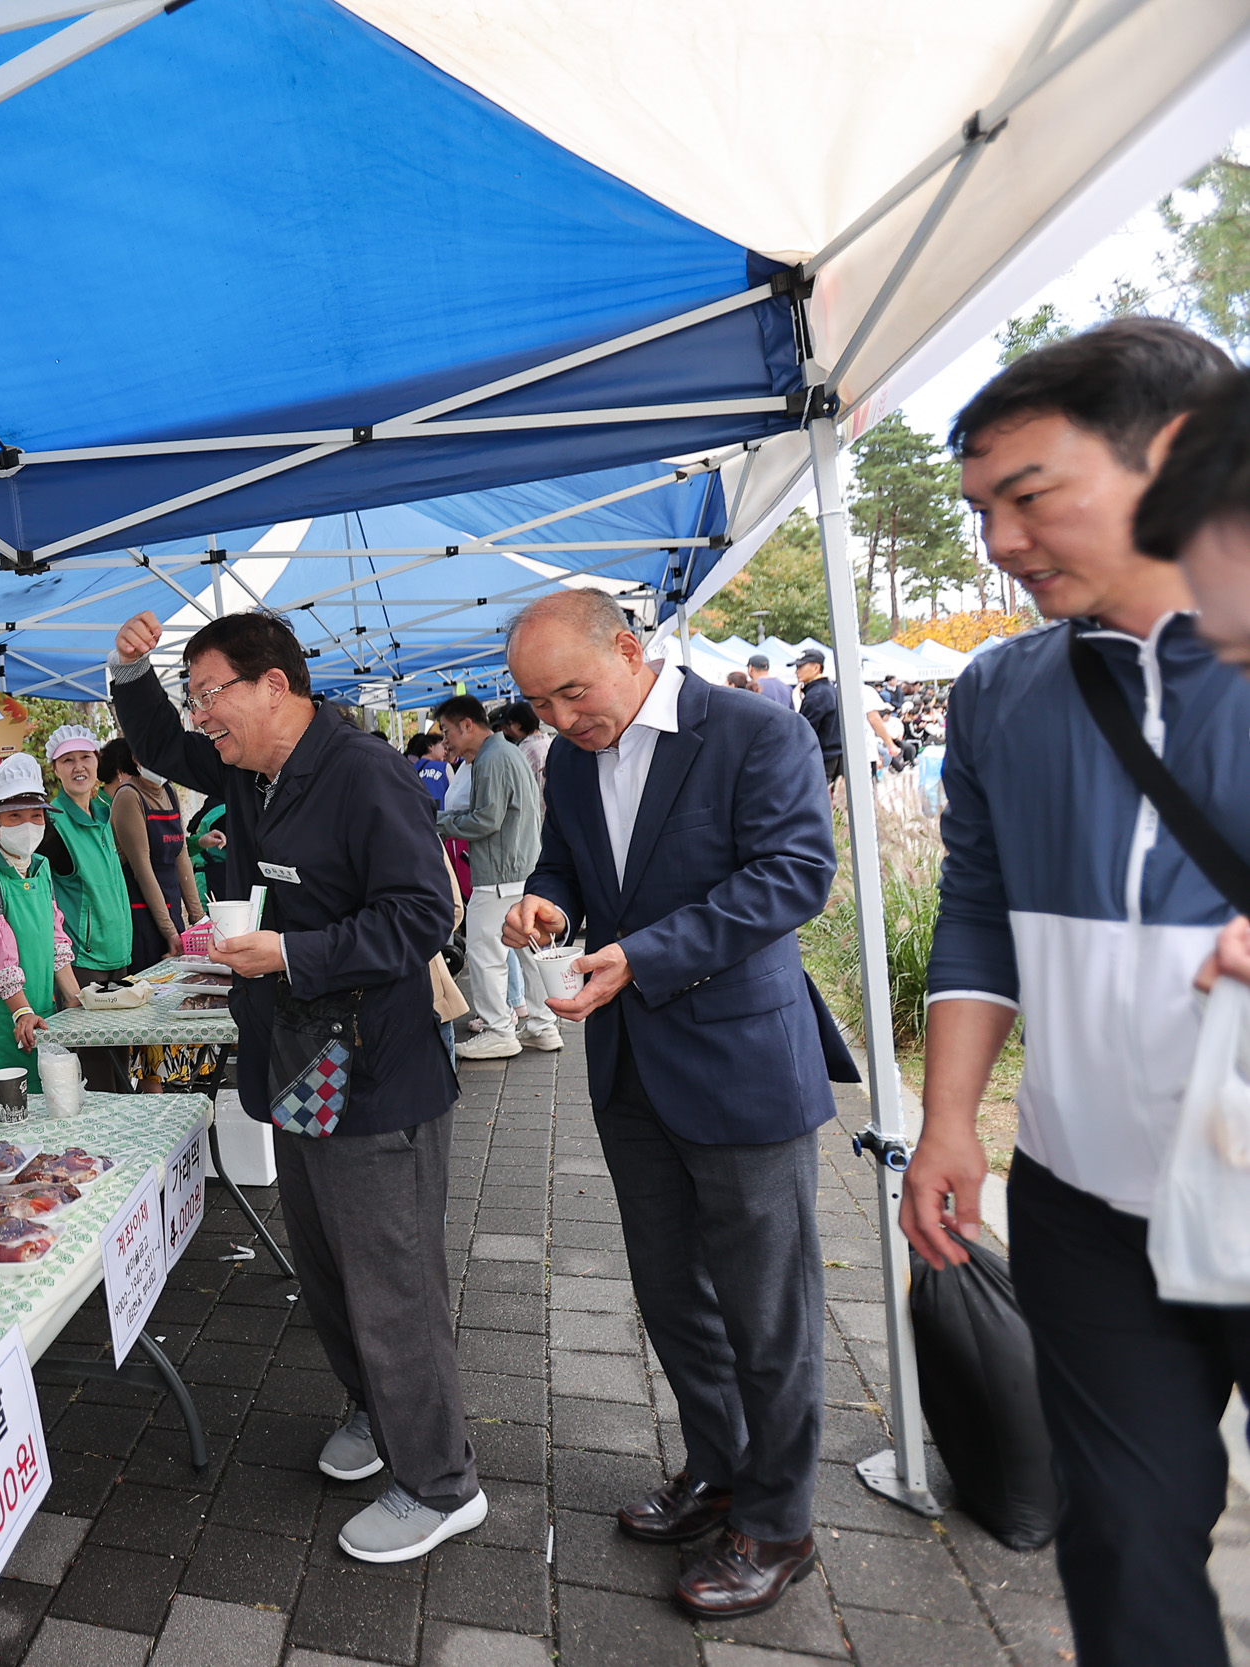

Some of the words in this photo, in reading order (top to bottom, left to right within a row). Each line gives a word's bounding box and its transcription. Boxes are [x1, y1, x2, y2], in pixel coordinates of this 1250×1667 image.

[172, 1138, 200, 1193] 가래떡
[116, 1199, 149, 1257] 계좌이체
[125, 1235, 149, 1279] 새마을금고
